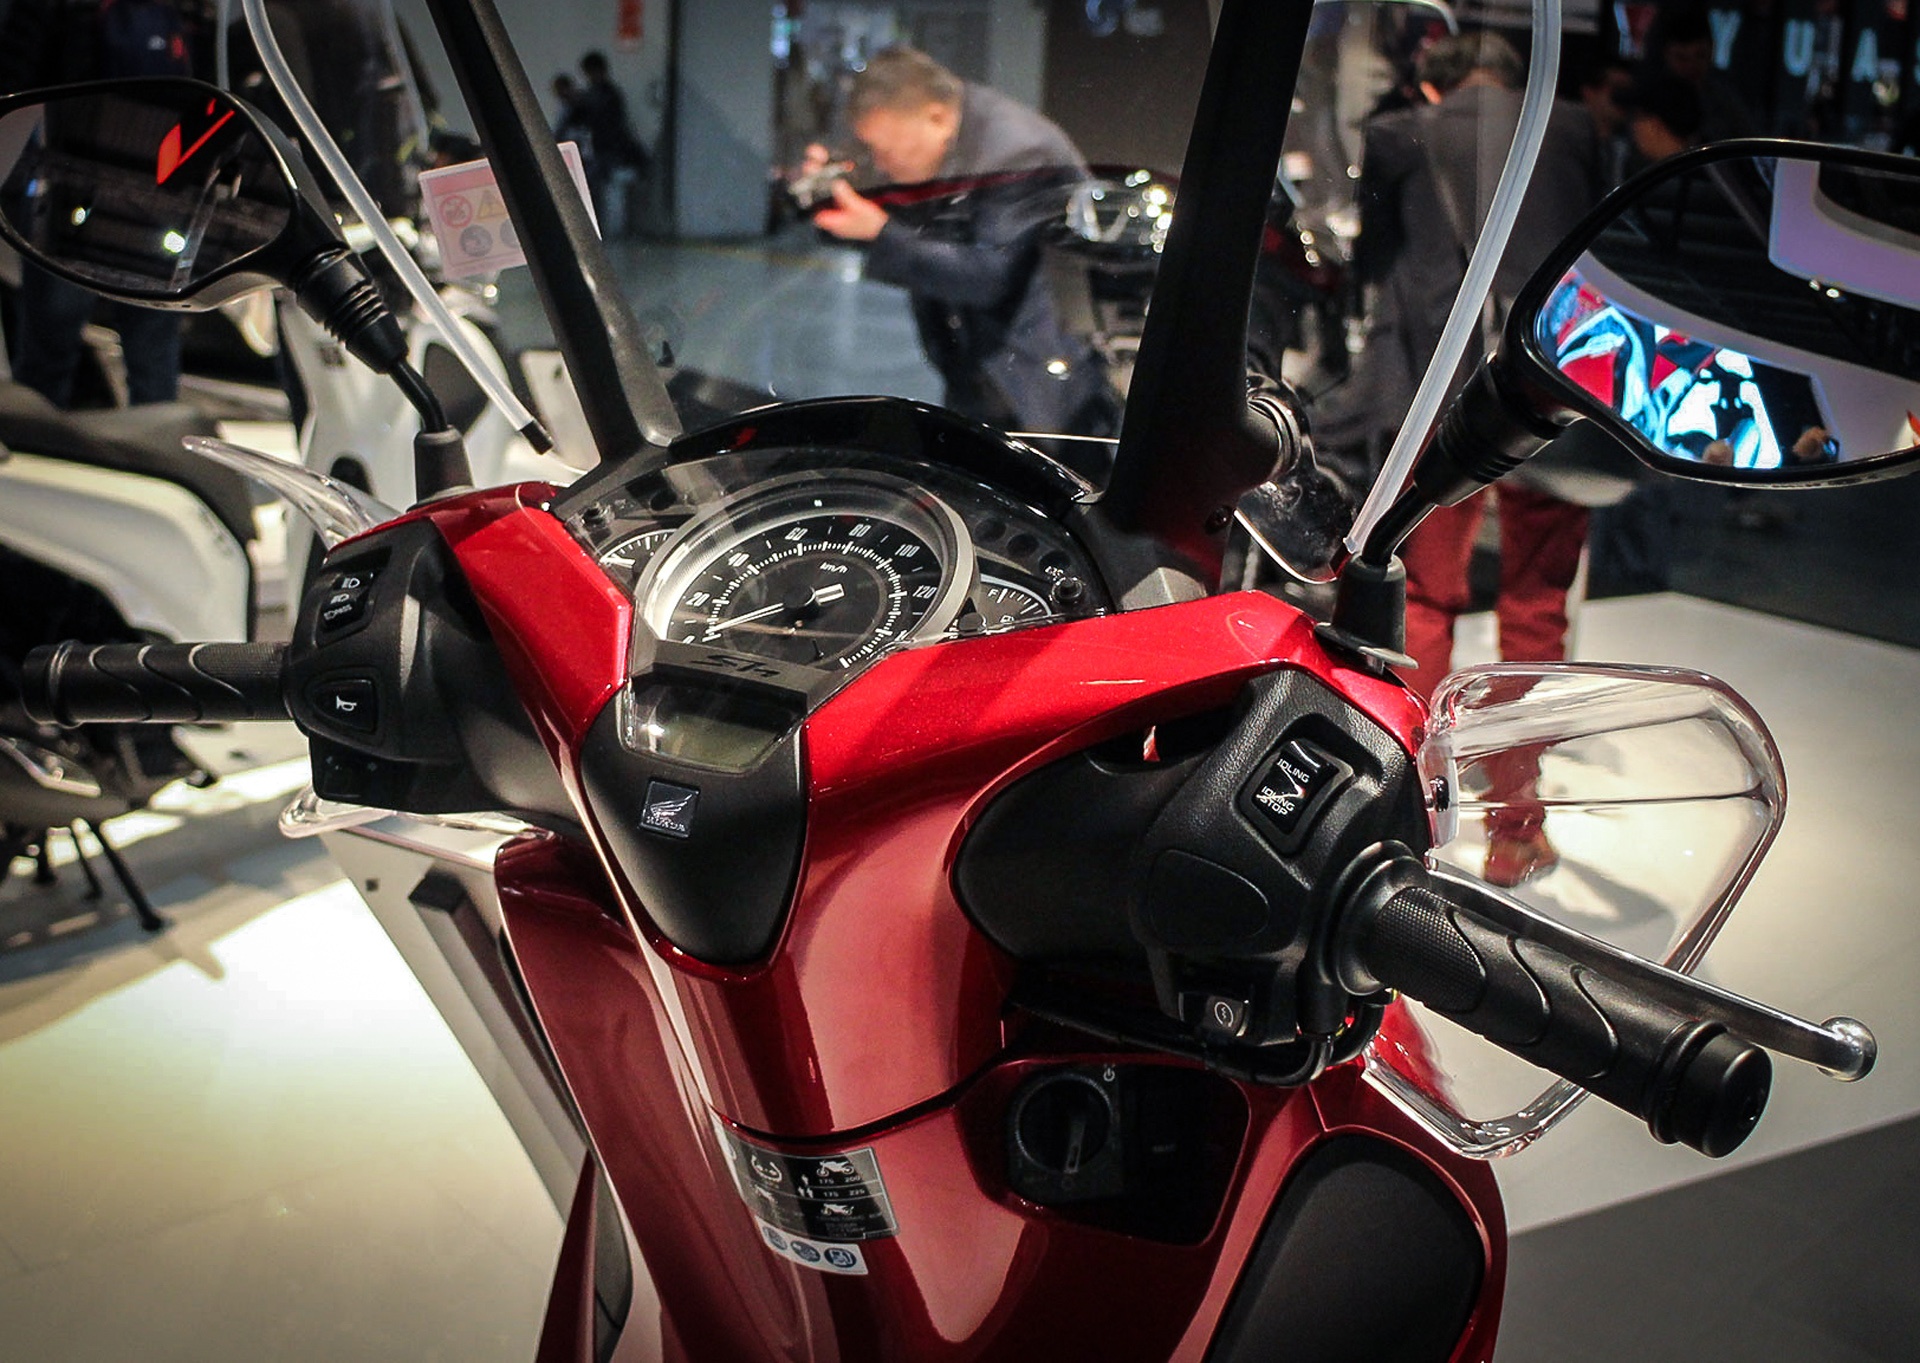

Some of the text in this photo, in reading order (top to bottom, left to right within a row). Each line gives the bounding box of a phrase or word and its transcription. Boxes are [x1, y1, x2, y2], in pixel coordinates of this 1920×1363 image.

[1708, 8, 1920, 86] YUA
[784, 526, 809, 541] 60
[849, 523, 872, 538] 80
[895, 544, 920, 557] 100
[728, 552, 750, 567] 40
[820, 561, 849, 574] km/h
[685, 591, 711, 607] 20
[912, 584, 938, 599] 120
[987, 588, 999, 597] F
[1277, 759, 1310, 783] IDLING
[1260, 796, 1288, 815] STOP
[1261, 786, 1295, 811] IDLING
